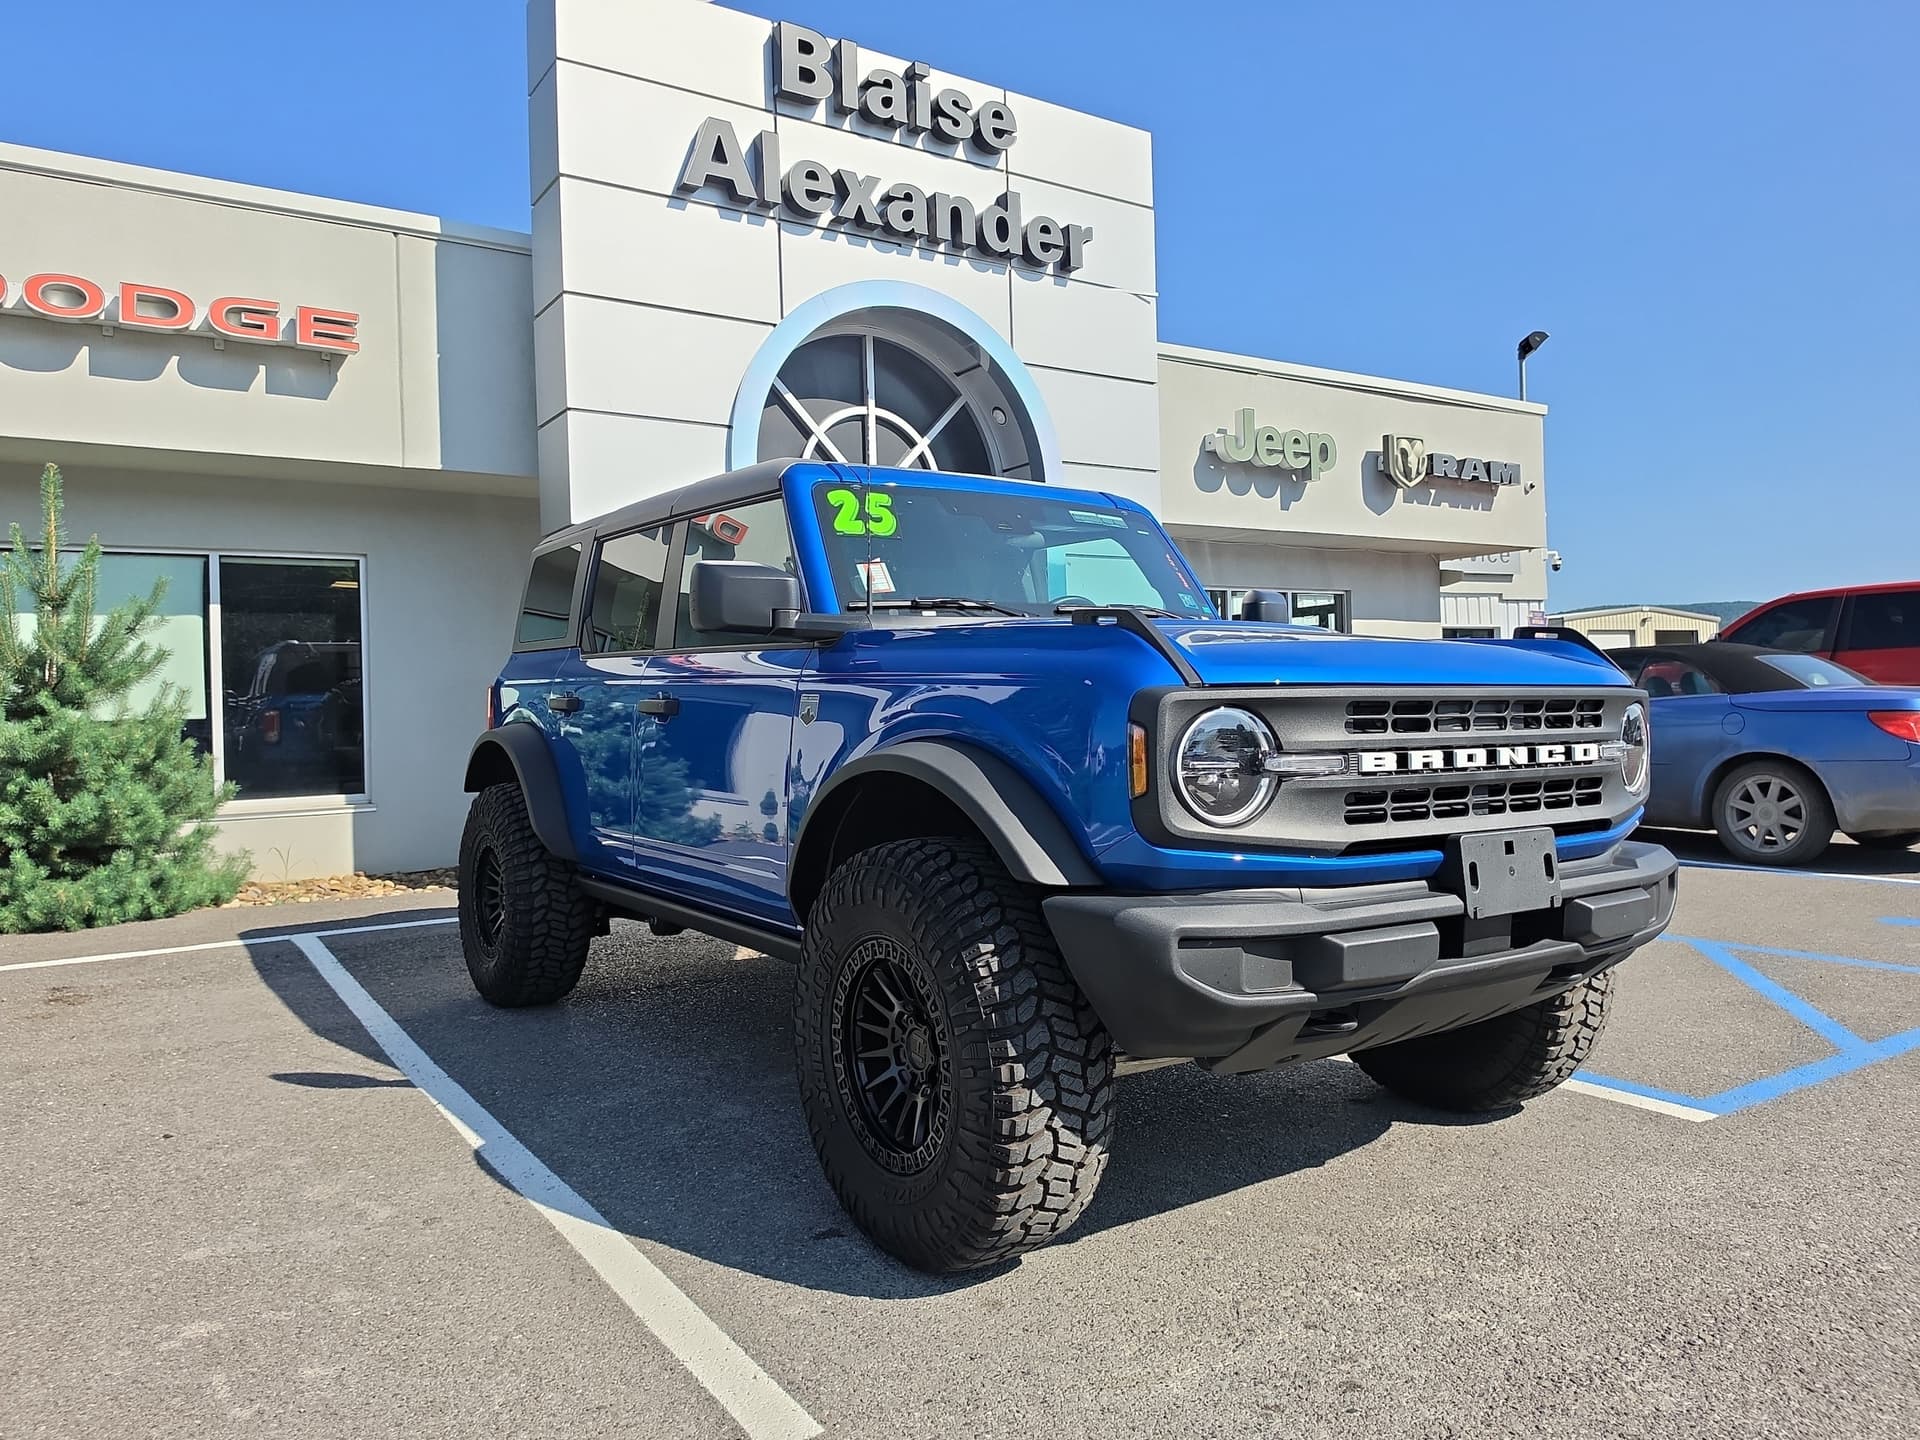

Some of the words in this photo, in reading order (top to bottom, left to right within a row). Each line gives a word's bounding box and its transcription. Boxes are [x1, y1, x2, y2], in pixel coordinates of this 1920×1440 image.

[774, 20, 1017, 155] Blaise
[679, 116, 1094, 272] Alexander
[0, 272, 360, 353] ODGE
[1215, 407, 1338, 482] Jeep
[1429, 453, 1522, 486] RAM
[825, 489, 898, 537] 25
[1359, 744, 1600, 773] BRONCO
